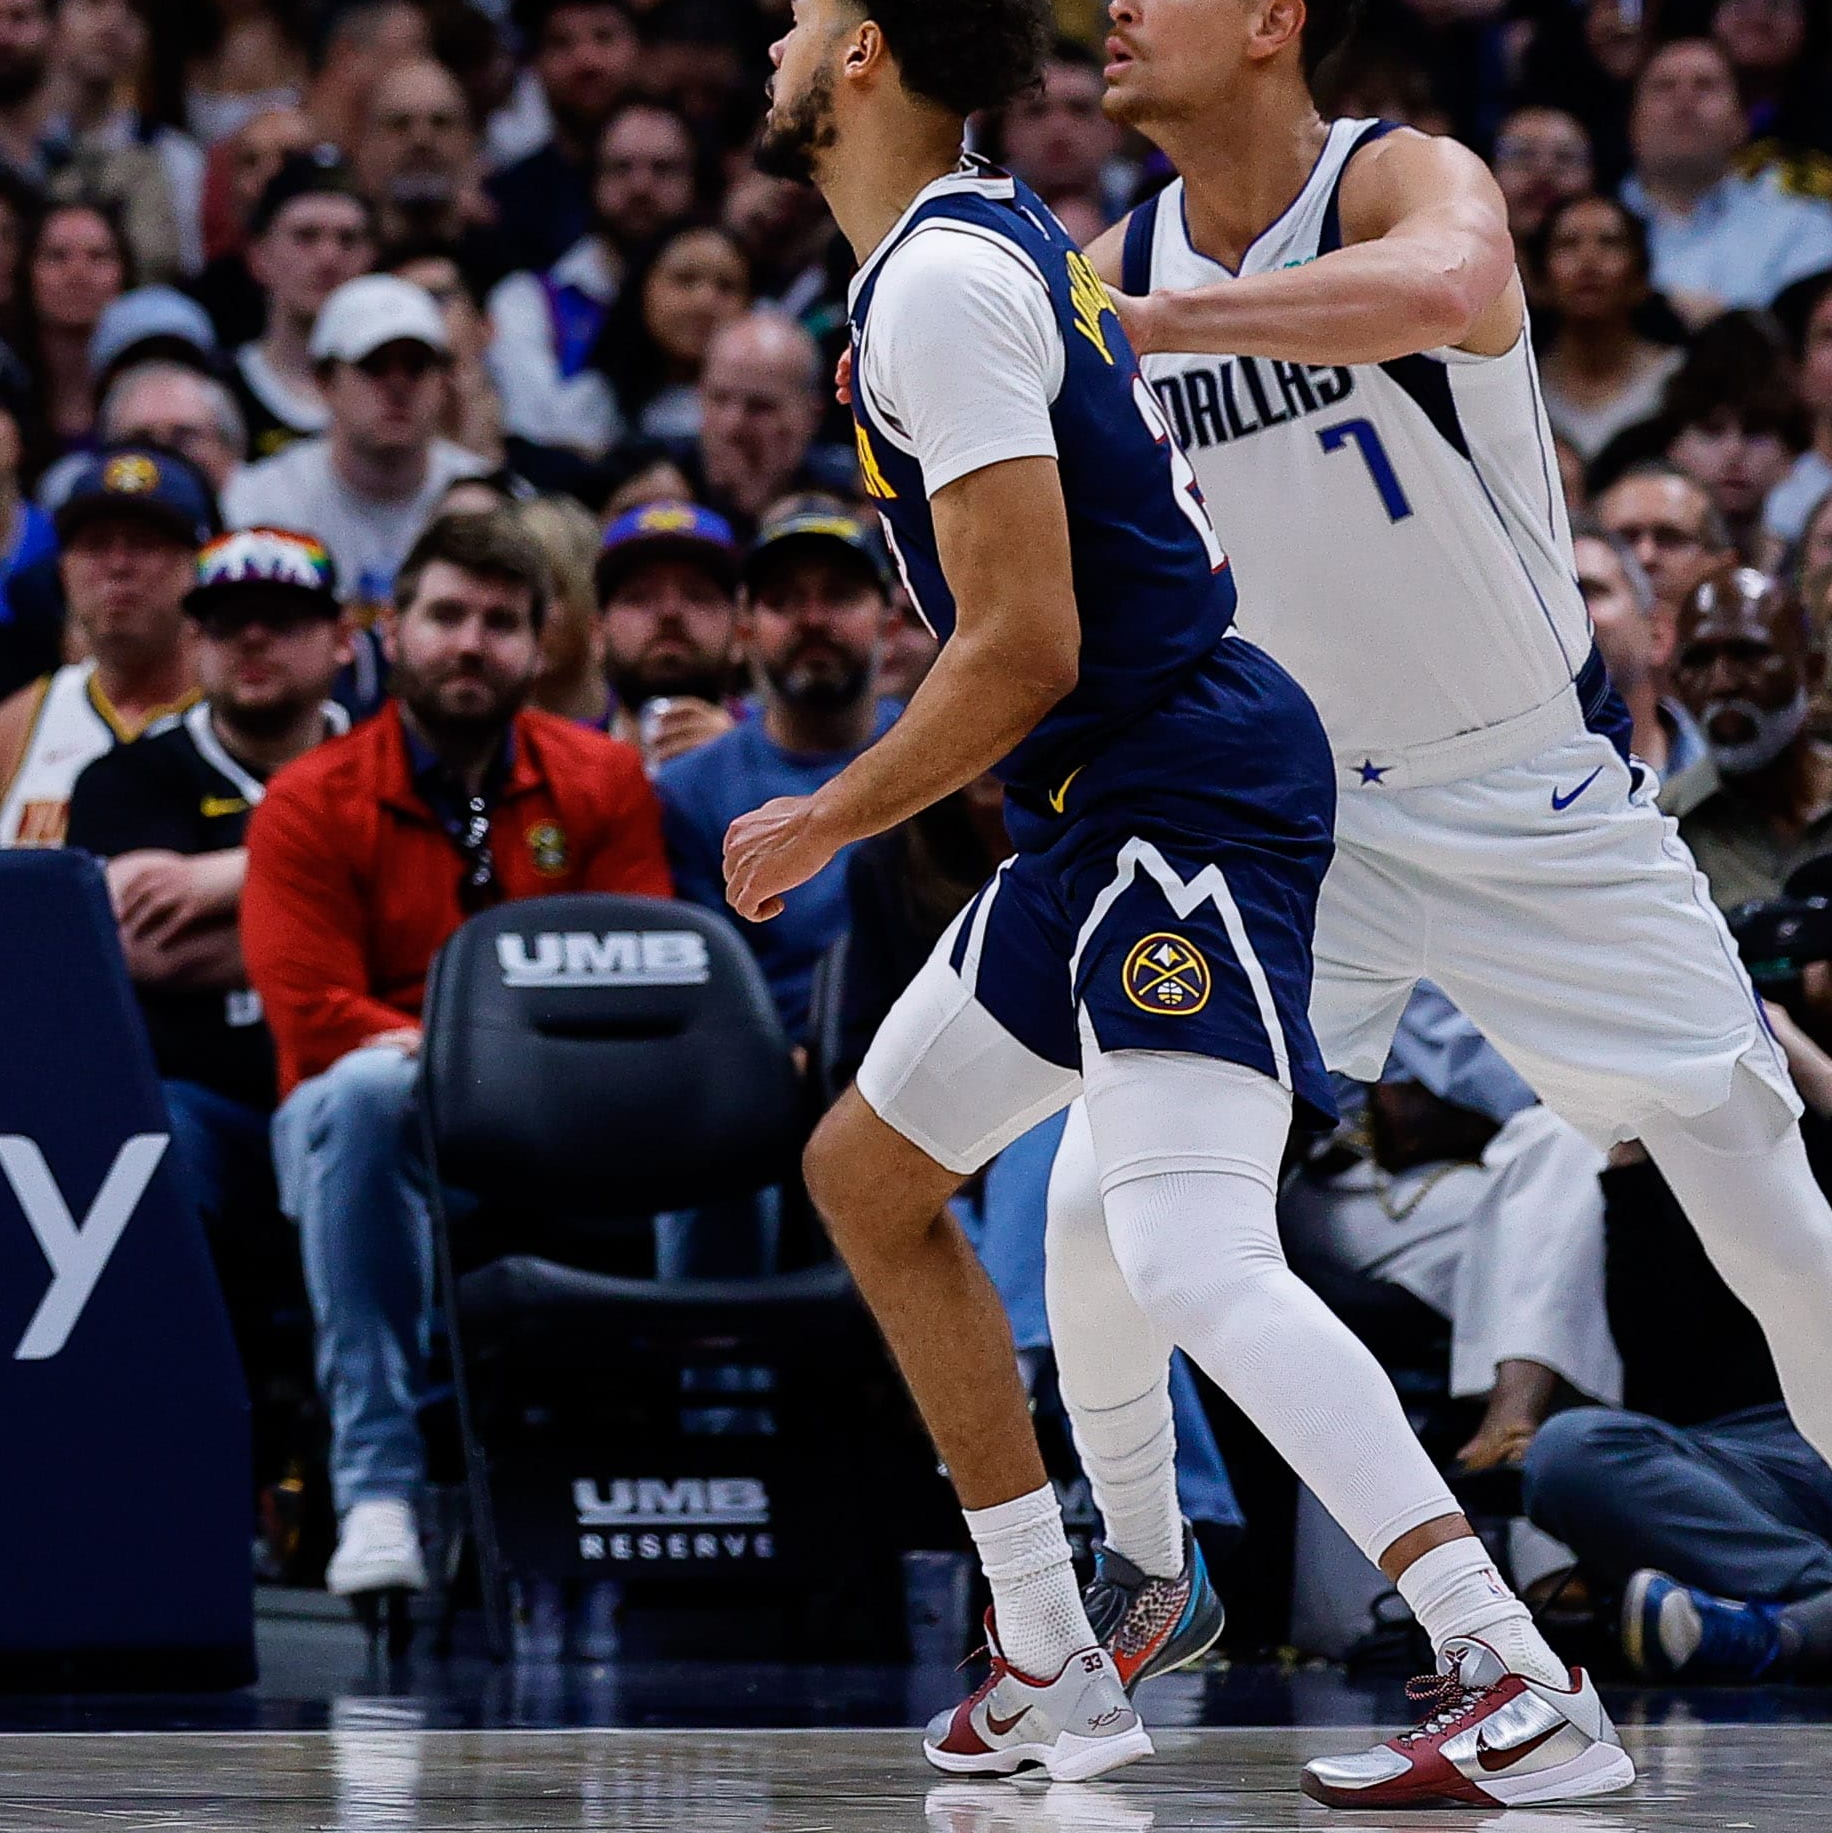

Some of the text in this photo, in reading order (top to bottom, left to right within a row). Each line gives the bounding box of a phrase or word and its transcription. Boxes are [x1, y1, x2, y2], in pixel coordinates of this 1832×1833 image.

[1151, 355, 1354, 451] DALLAS
[1317, 418, 1414, 525] 7
[496, 931, 709, 980] UMB
[570, 1475, 772, 1514] UMB
[577, 1530, 777, 1562] RESERVE
[1081, 1652, 1104, 1673] 33
